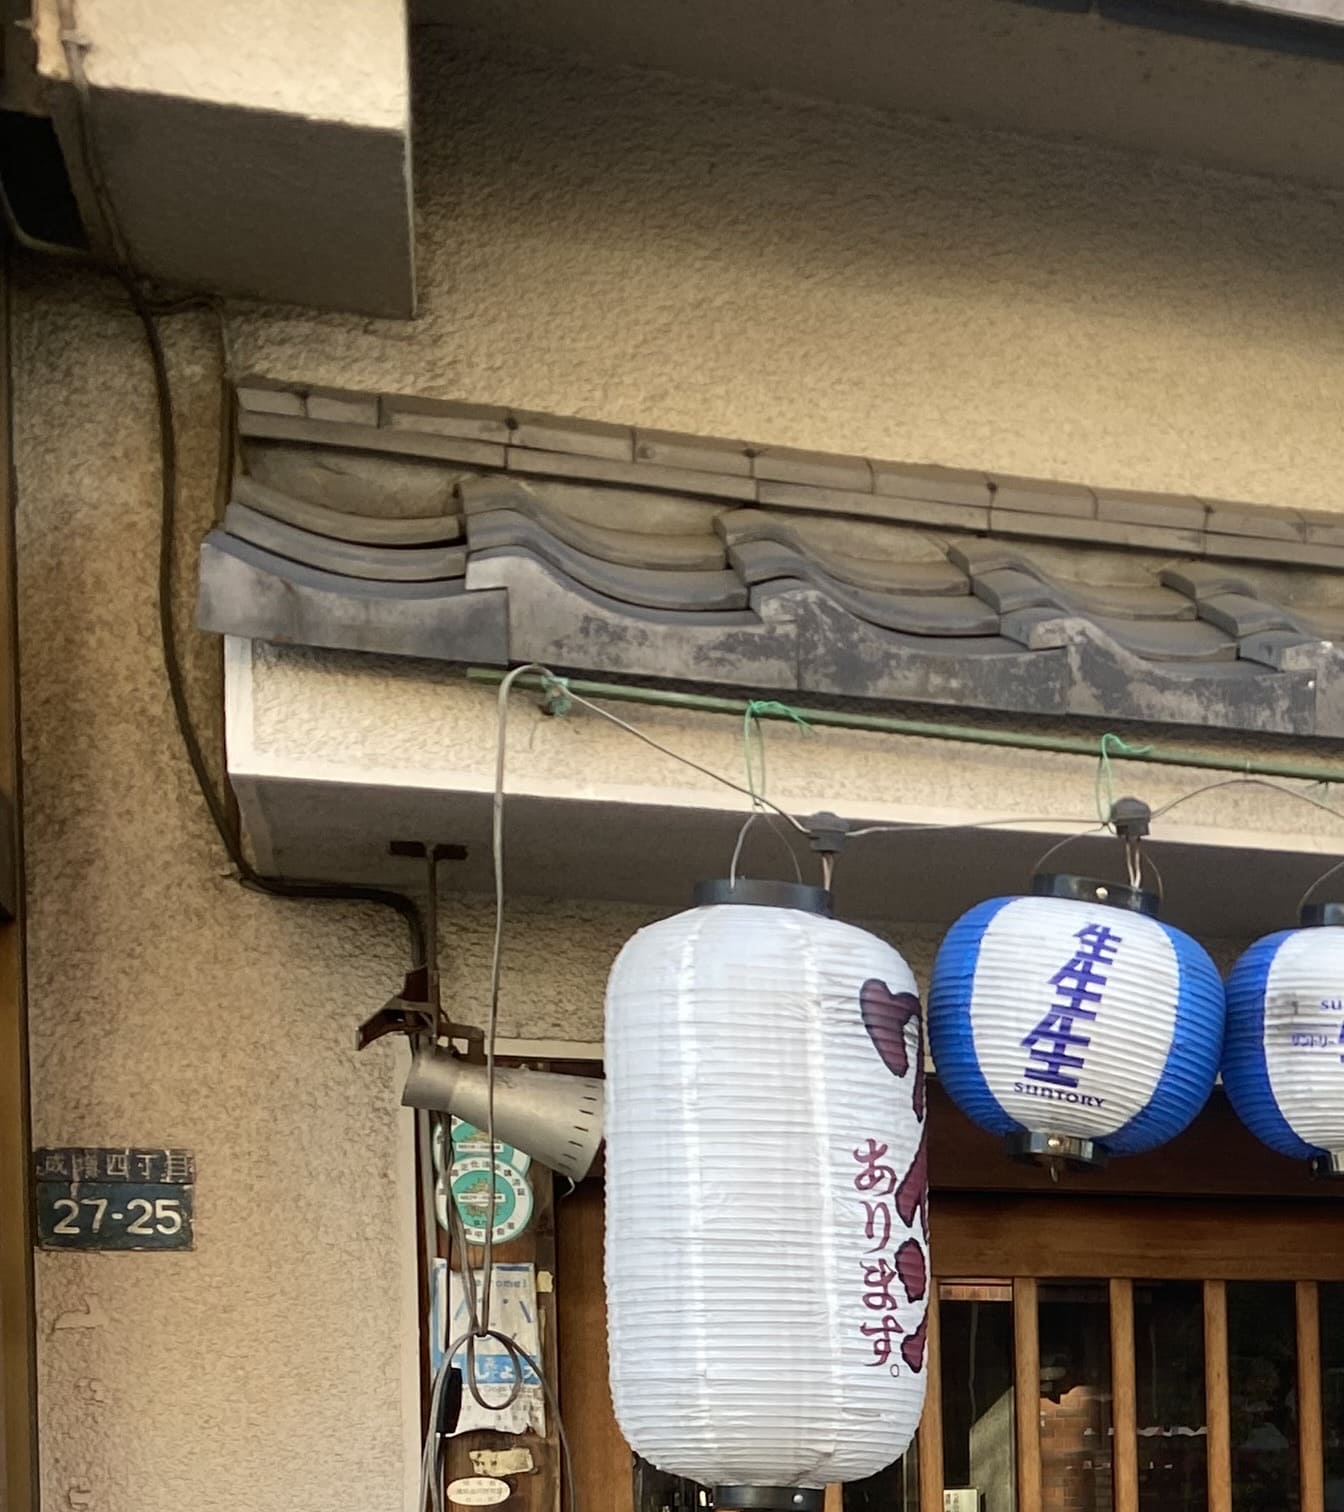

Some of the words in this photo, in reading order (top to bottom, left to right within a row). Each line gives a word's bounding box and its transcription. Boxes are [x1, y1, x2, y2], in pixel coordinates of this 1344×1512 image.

[1020, 922, 1122, 1088] 生生生
[1013, 1081, 1105, 1109] SUNTORY
[52, 1198, 183, 1235] 27-25
